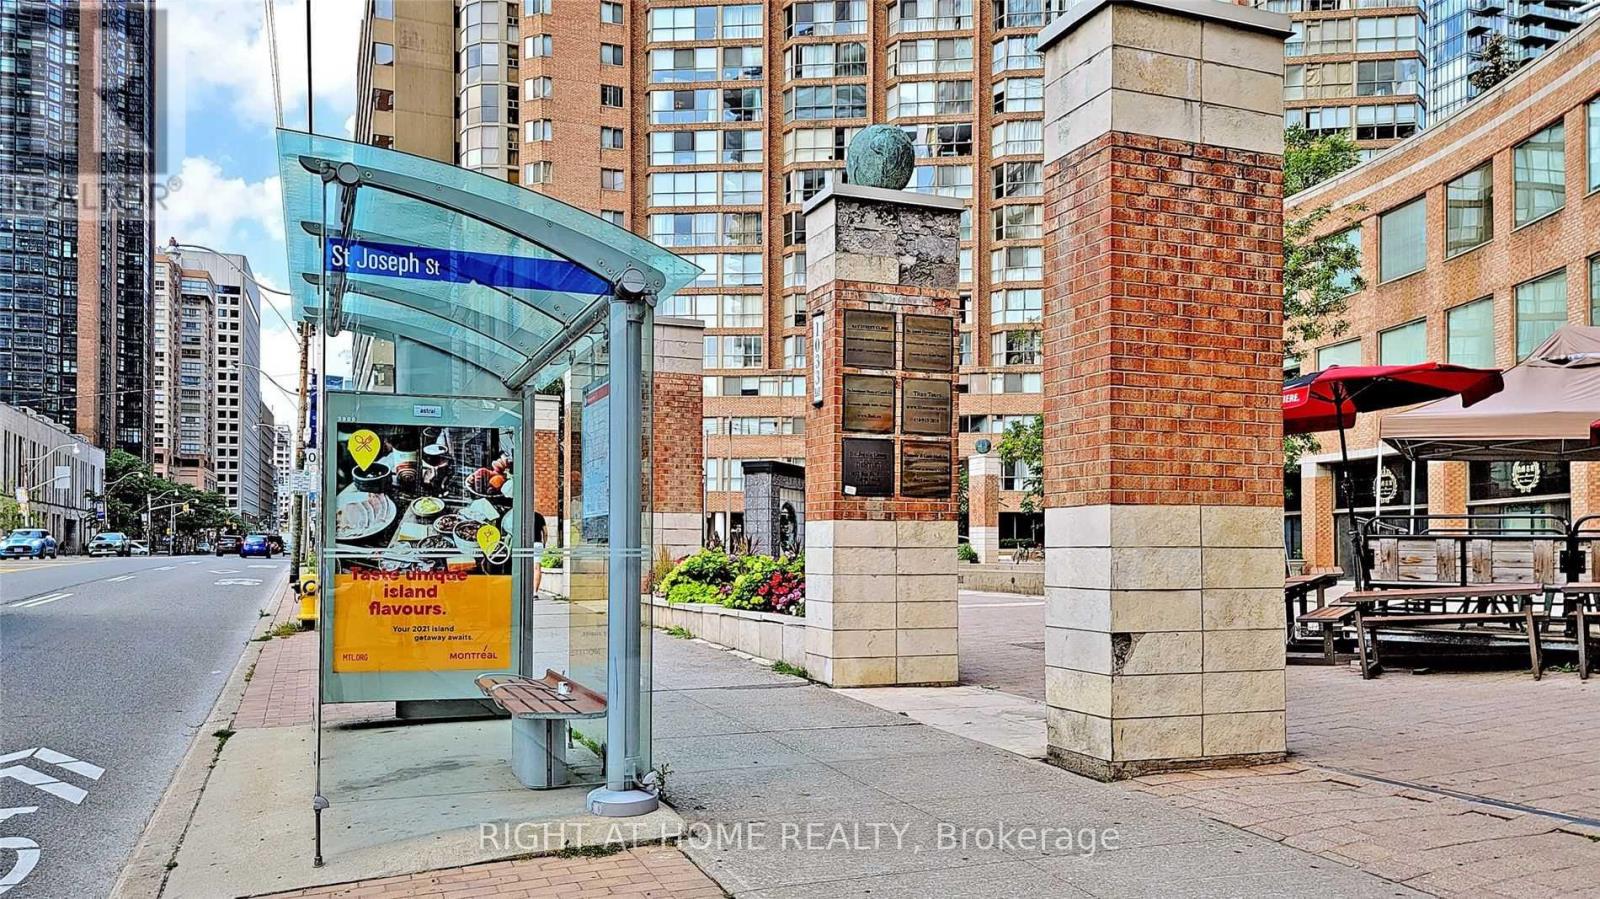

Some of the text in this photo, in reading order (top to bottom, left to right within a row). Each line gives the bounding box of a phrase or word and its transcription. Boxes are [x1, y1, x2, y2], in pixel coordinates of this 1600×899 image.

[331, 244, 441, 276] St Joseph St
[351, 567, 468, 584] Taste unique
[383, 583, 438, 599] island
[368, 601, 446, 616] flavours.
[392, 625, 455, 633] Your 2021 island
[414, 633, 474, 642] getaway awaits.
